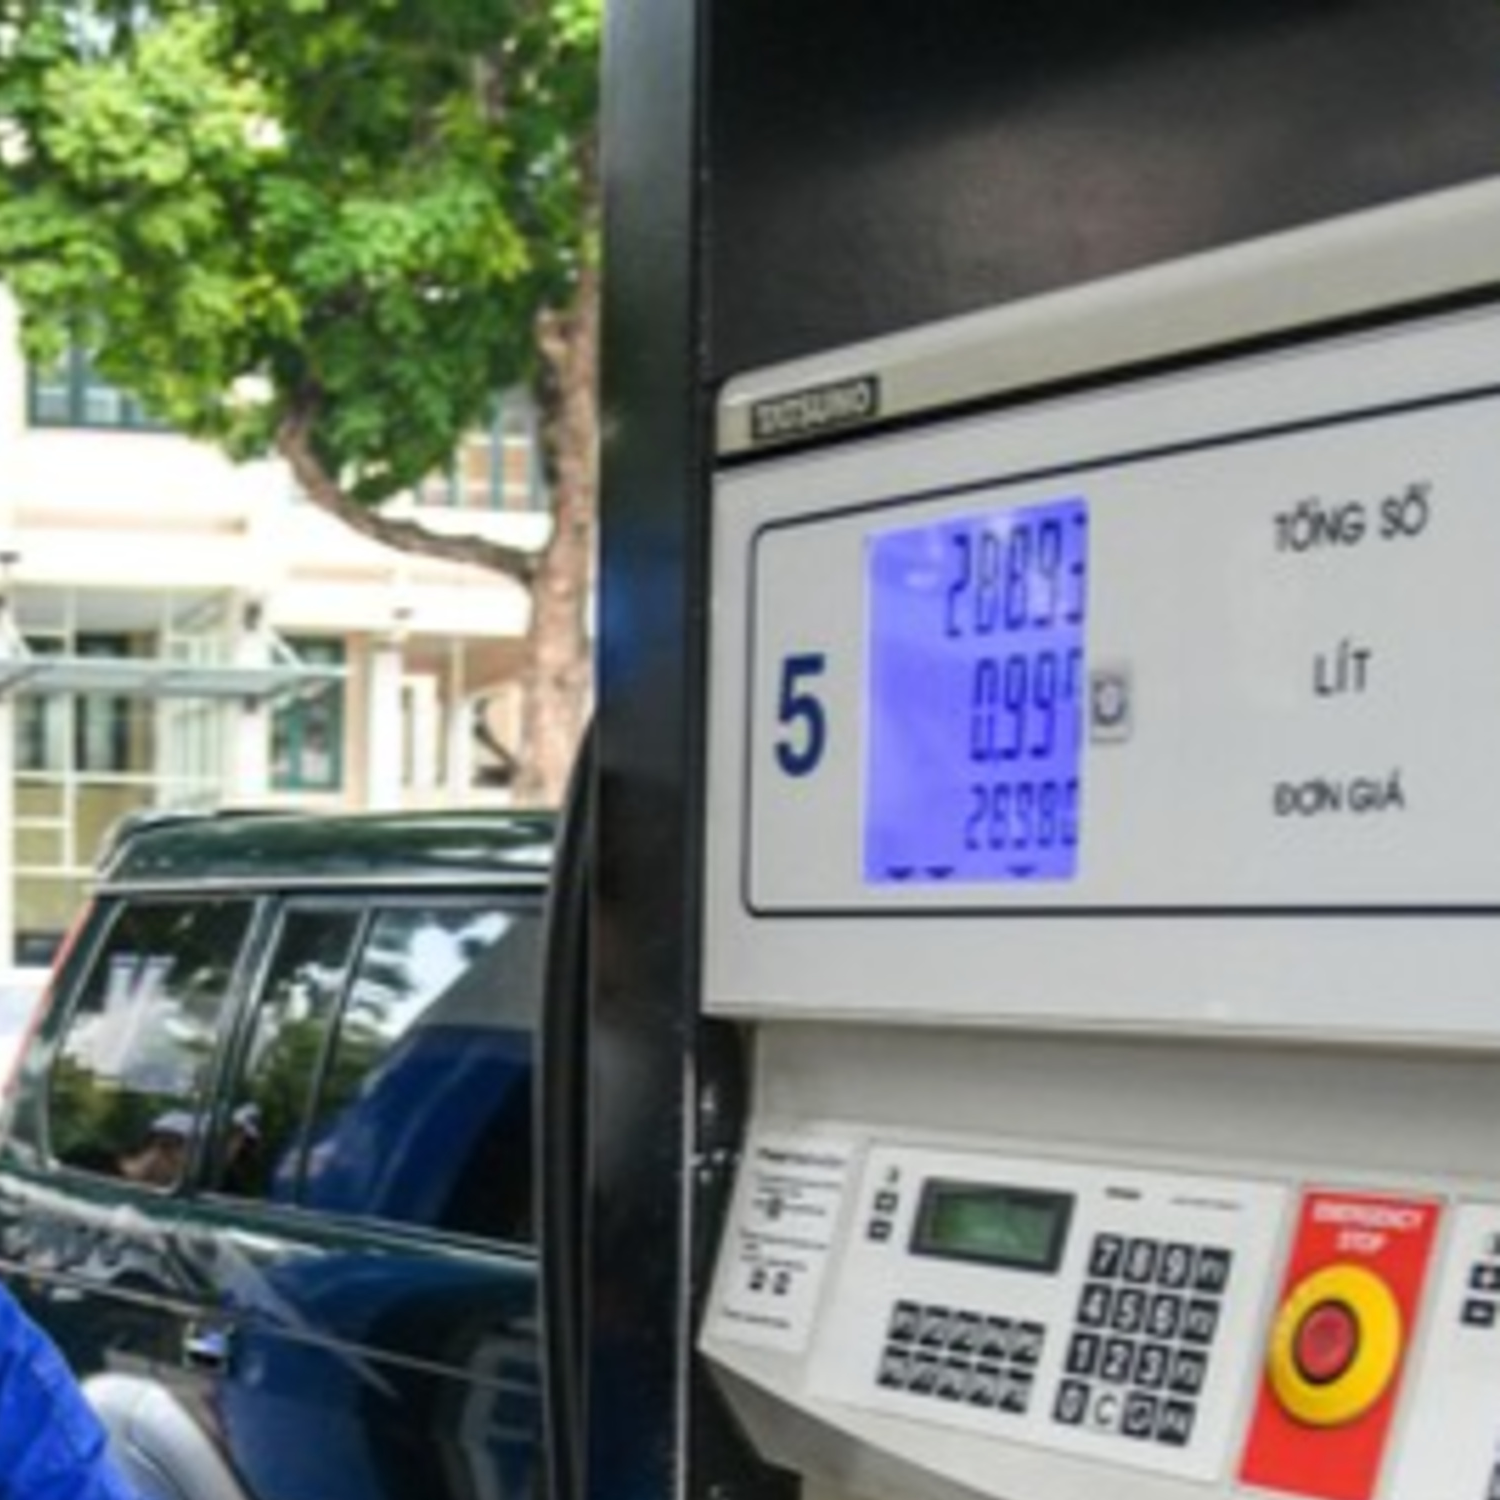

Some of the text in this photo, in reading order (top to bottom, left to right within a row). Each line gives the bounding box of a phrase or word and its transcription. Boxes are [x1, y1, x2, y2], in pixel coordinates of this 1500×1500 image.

[1274, 482, 1432, 552] TỔNG SỐ
[1313, 637, 1372, 697] LÍT
[775, 653, 827, 777] 5
[1273, 766, 1405, 817] ĐƠN GIÁ
[1334, 1230, 1388, 1256] STOP
